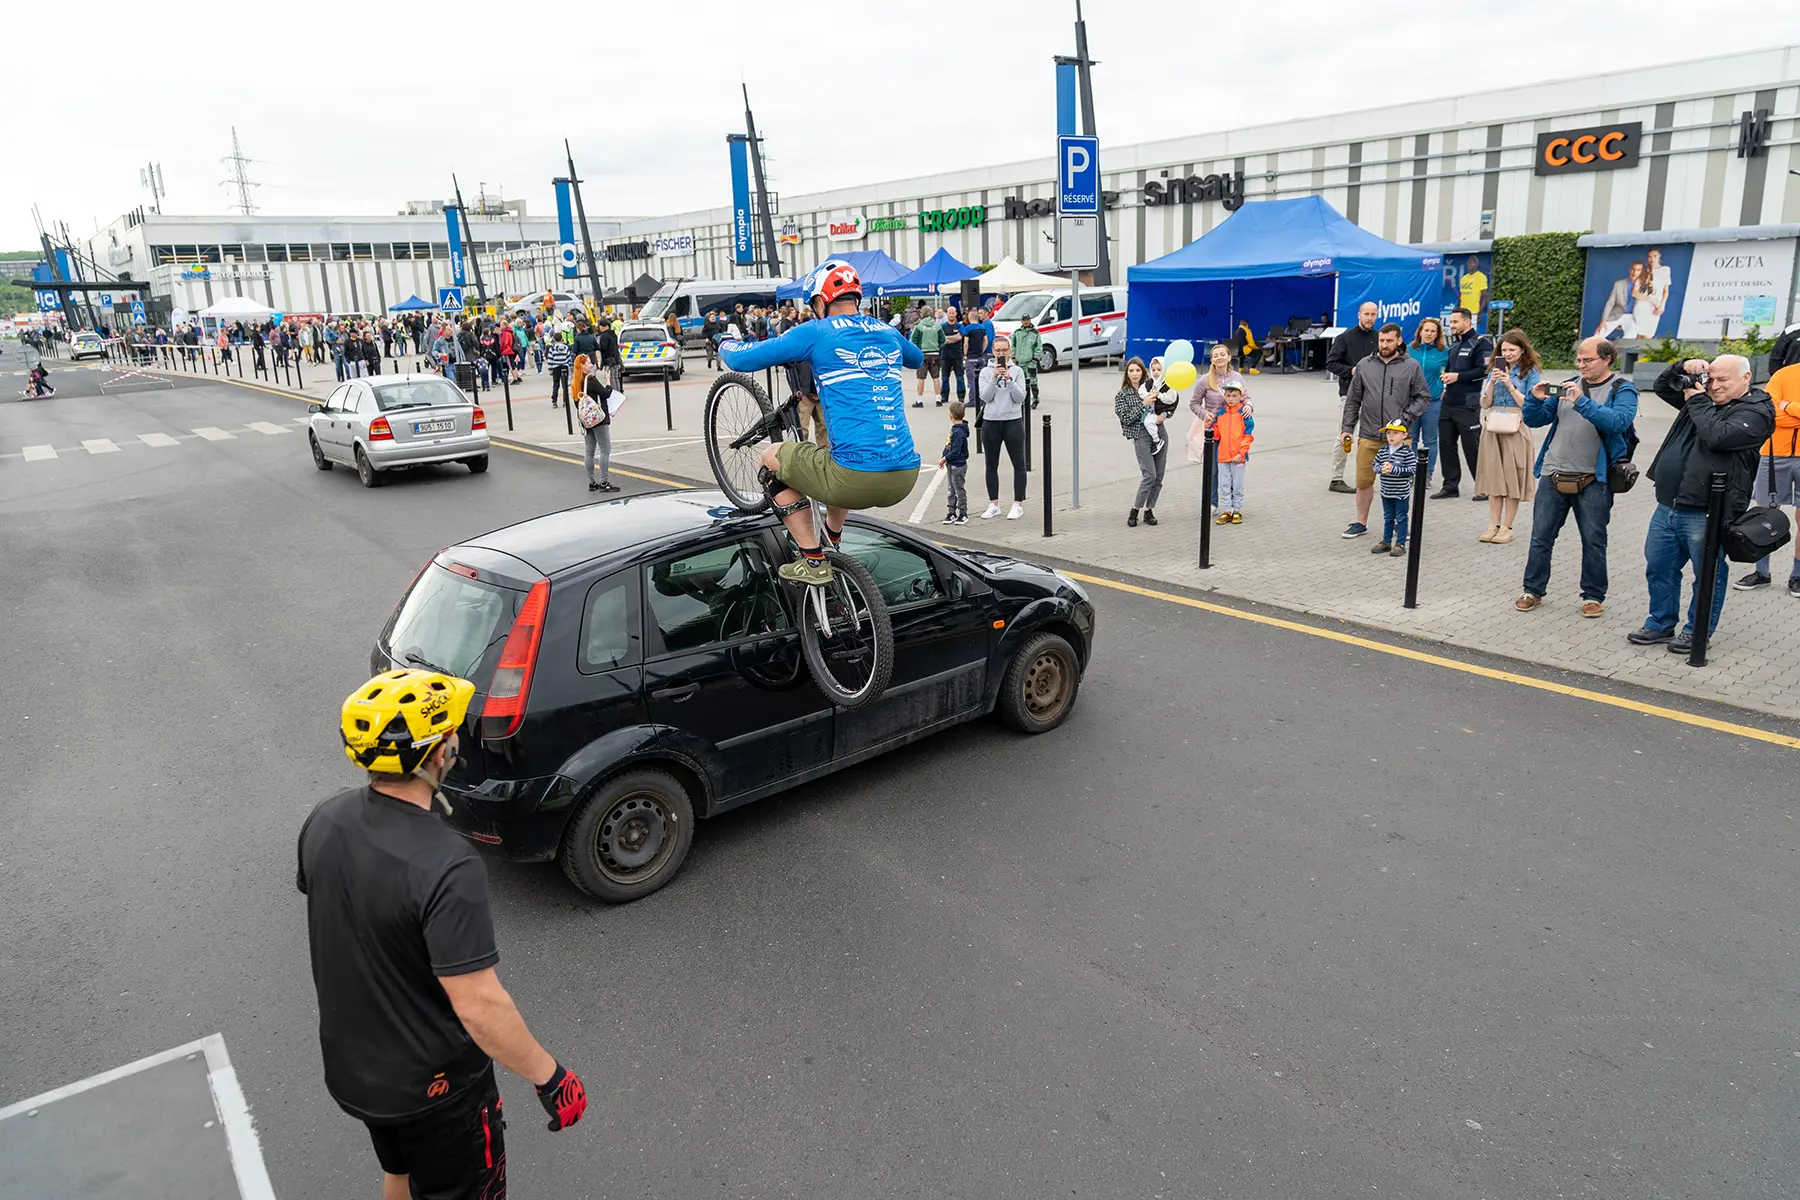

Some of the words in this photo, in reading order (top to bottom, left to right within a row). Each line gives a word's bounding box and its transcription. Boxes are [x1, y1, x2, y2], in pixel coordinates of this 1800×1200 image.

[1545, 131, 1625, 166] CCC
[1067, 146, 1090, 189] P
[1063, 192, 1095, 203] RÉSERVÉ
[1143, 170, 1244, 211] sinsay
[782, 220, 796, 236] dm
[918, 205, 985, 233] CROPP
[736, 208, 747, 252] olympia
[606, 242, 650, 262] HUMANIC
[655, 236, 692, 251] FISCHER
[1303, 258, 1331, 268] olympia
[1714, 255, 1764, 269] OZETA
[1741, 279, 1773, 287] DESIGN
[1378, 297, 1420, 323] lympia
